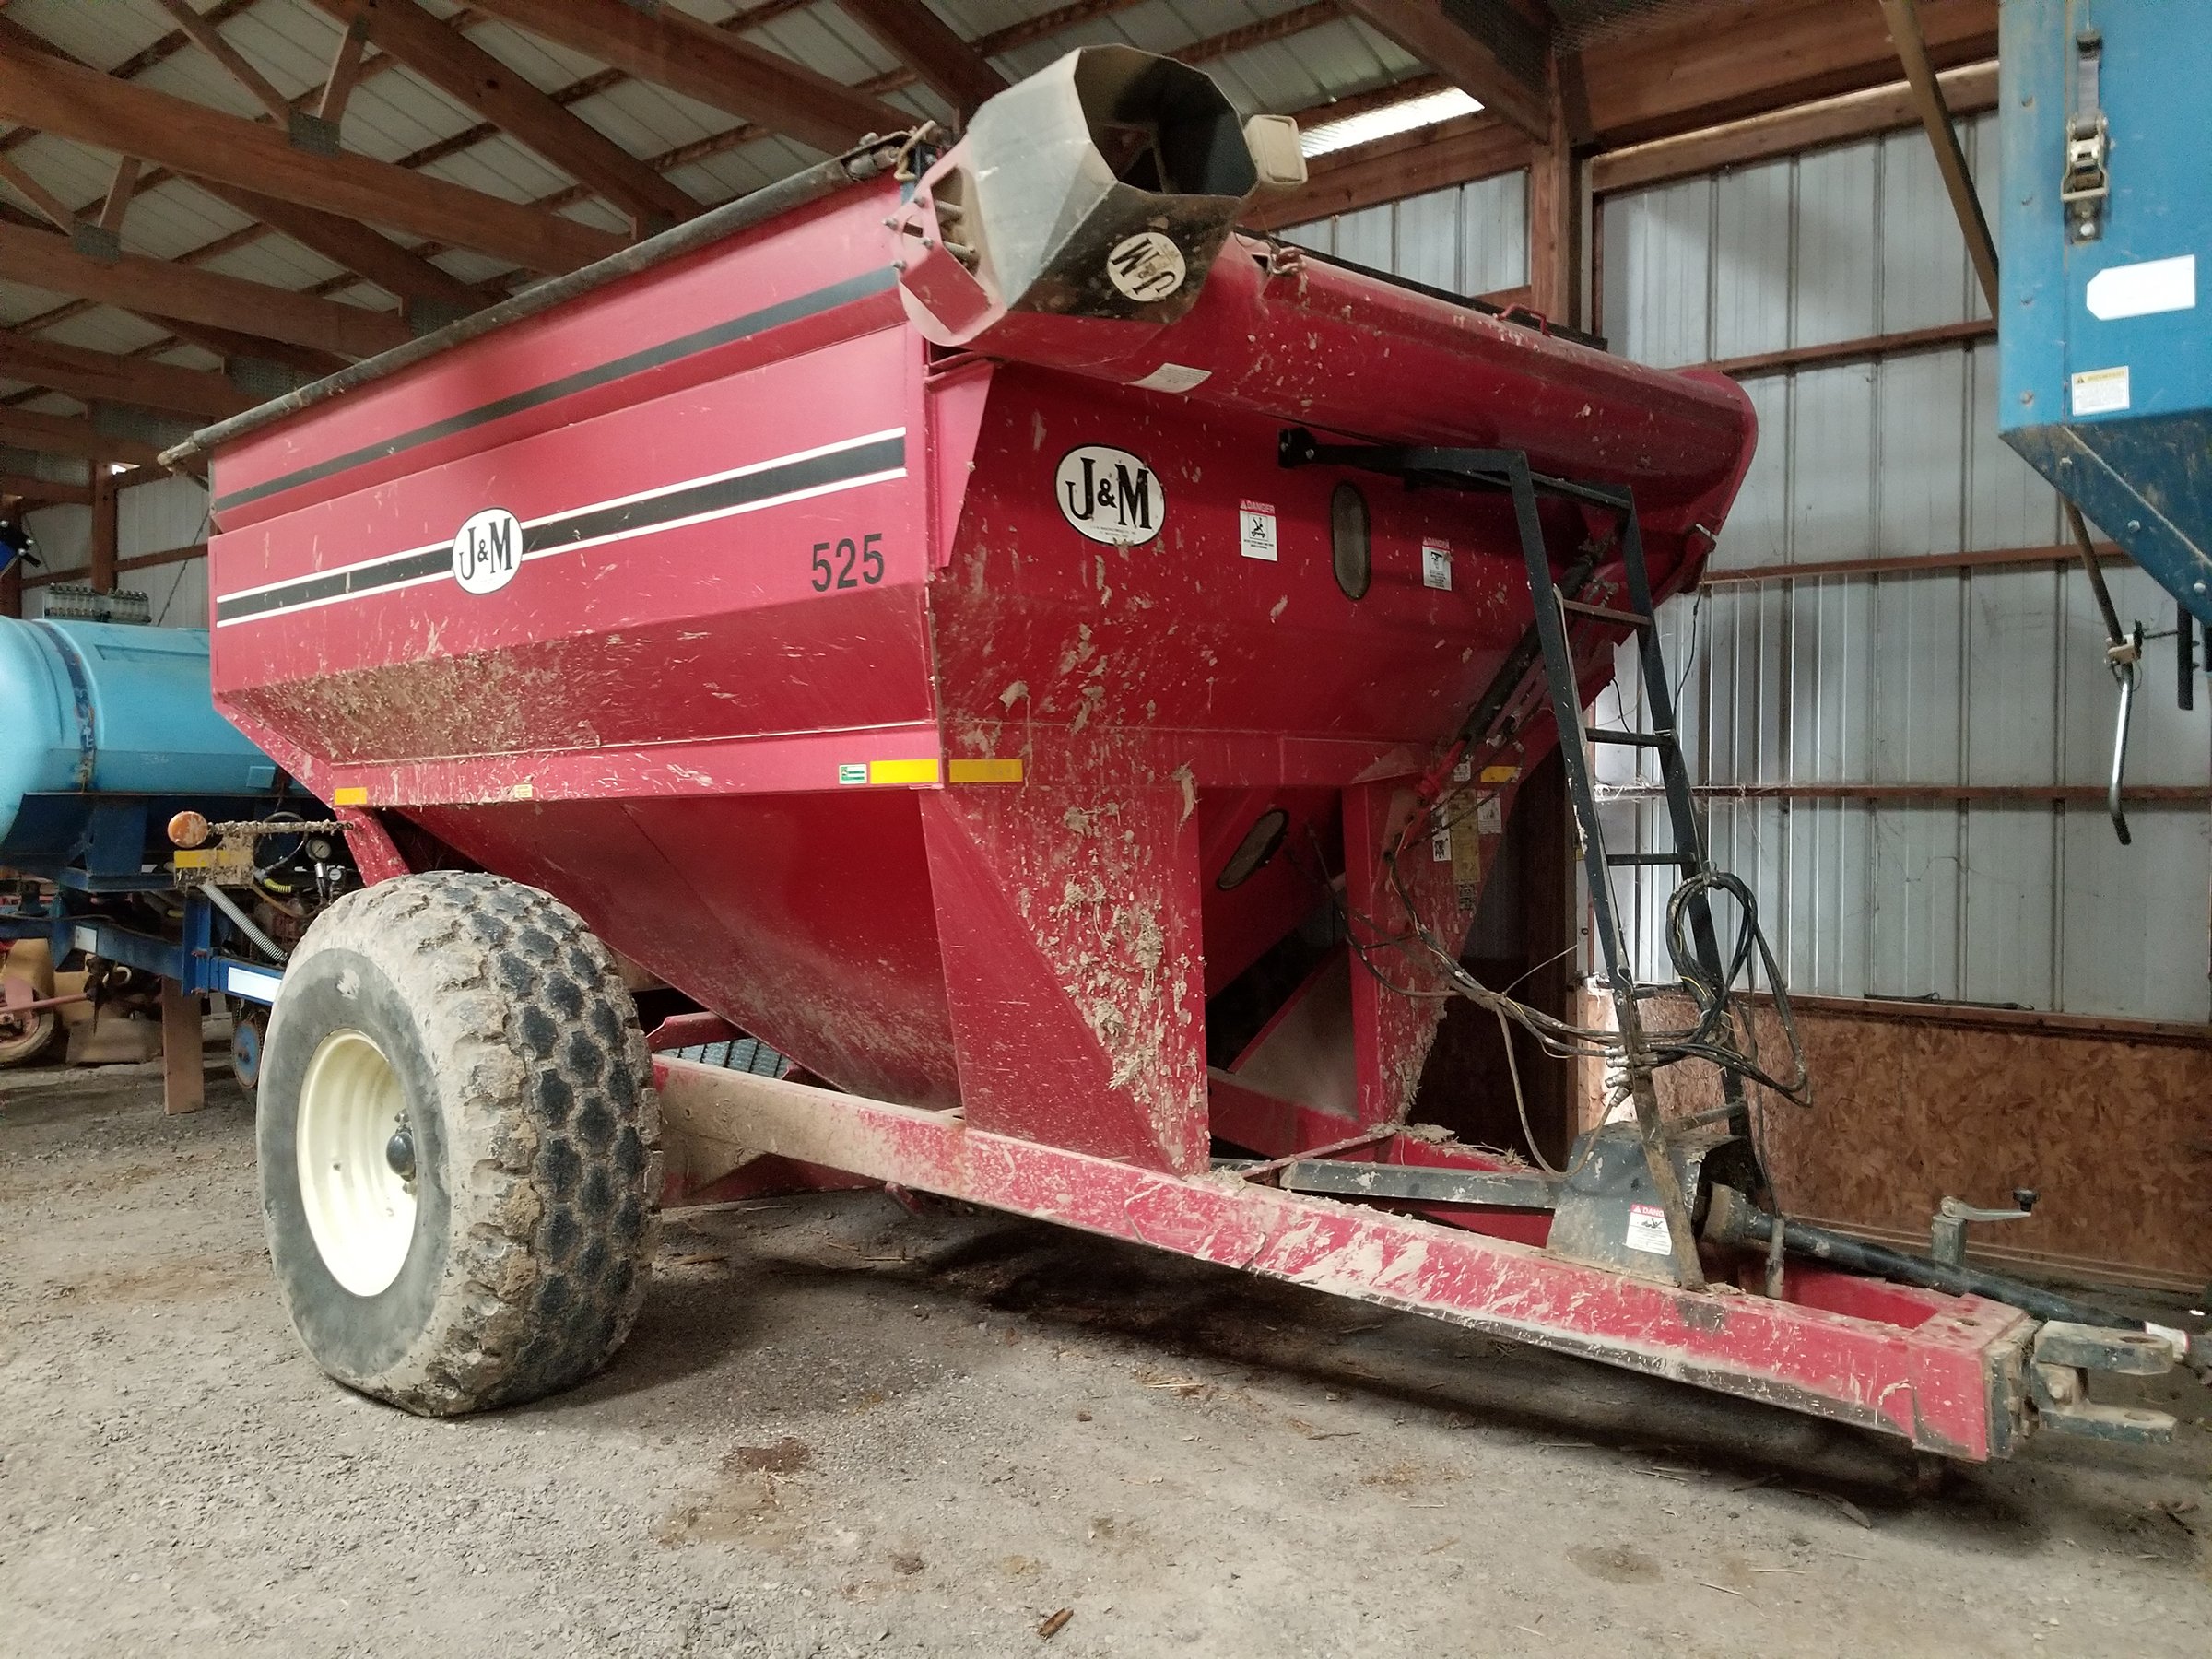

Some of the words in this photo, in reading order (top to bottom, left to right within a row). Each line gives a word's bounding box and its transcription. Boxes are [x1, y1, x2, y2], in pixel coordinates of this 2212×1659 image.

[1065, 457, 1152, 529] J&M
[459, 517, 512, 580] J&M
[811, 533, 884, 592] 525
